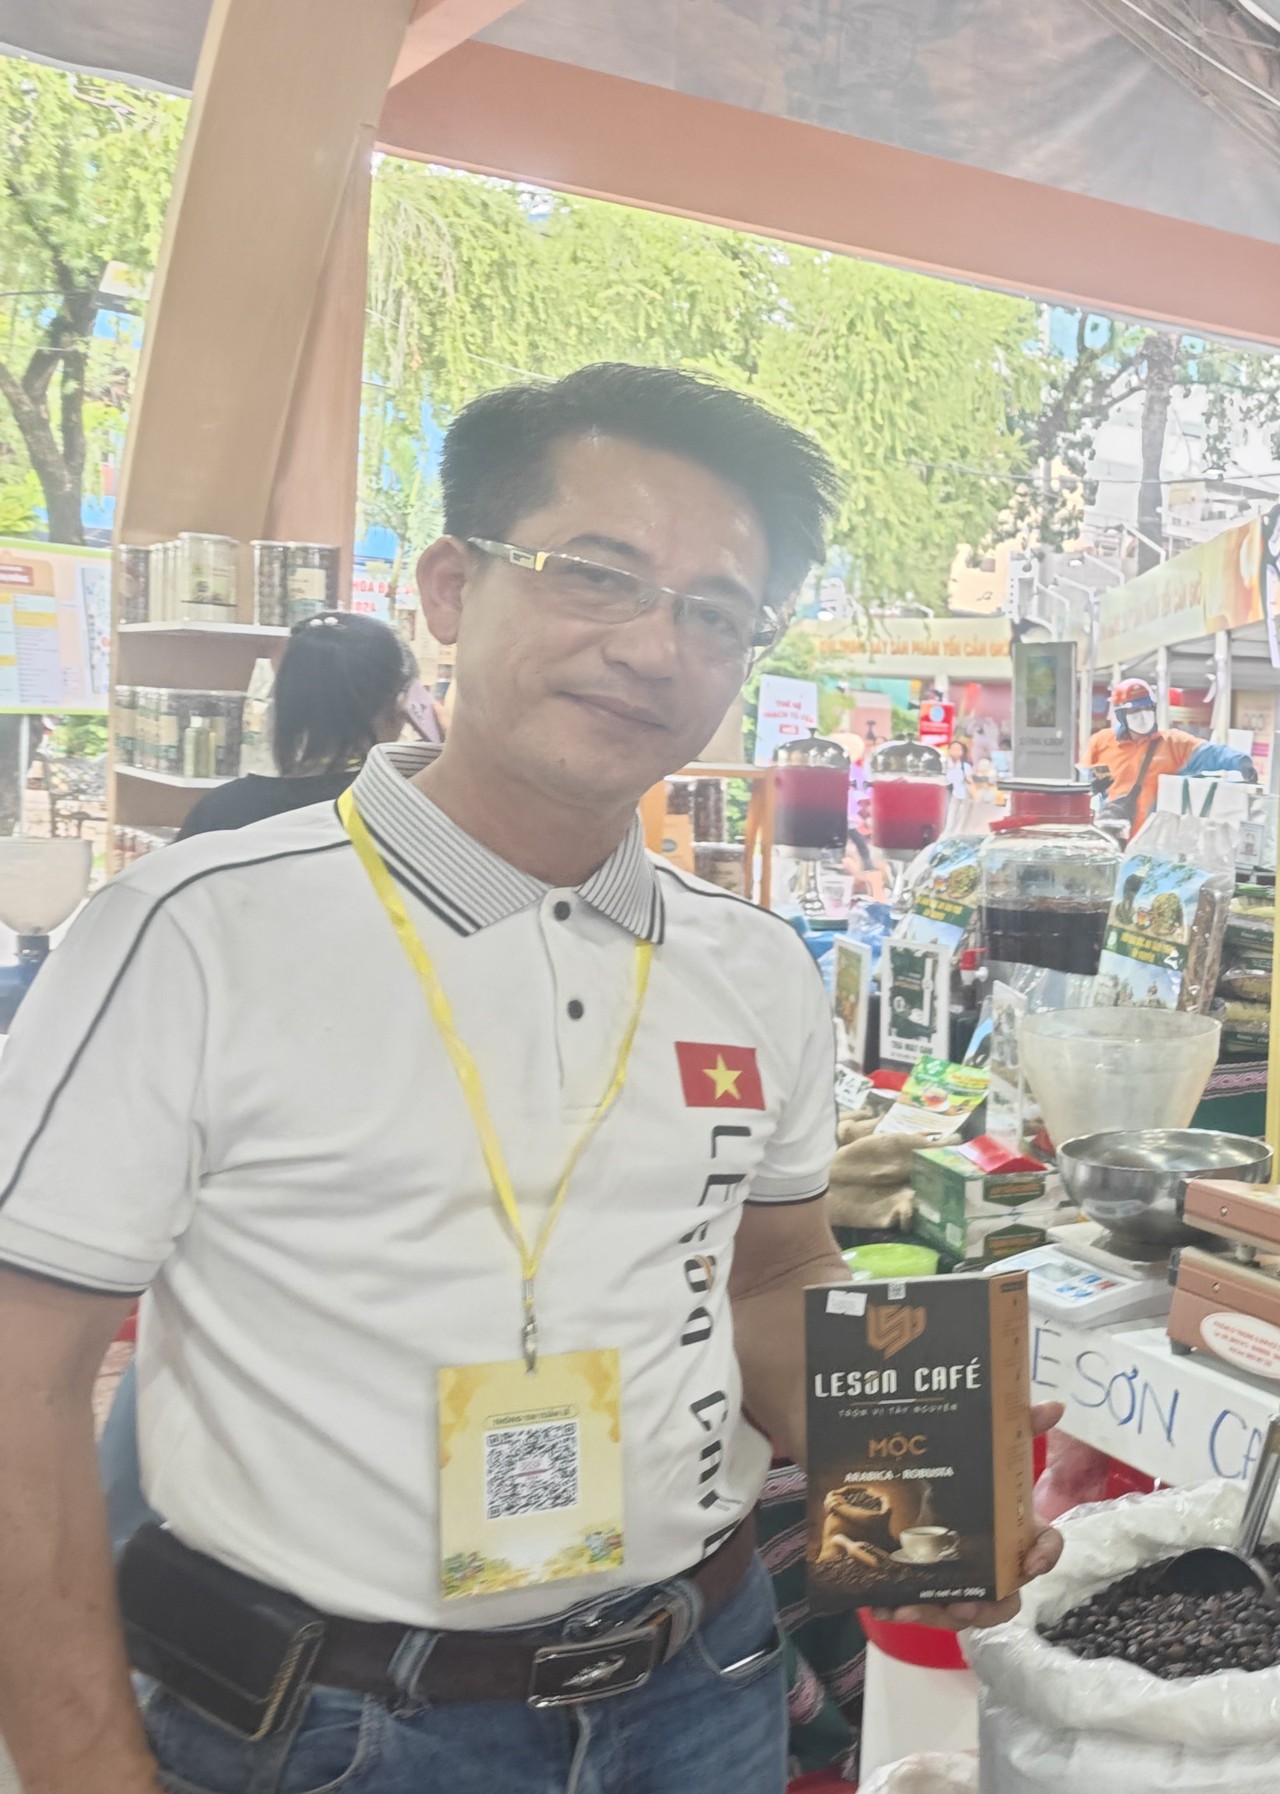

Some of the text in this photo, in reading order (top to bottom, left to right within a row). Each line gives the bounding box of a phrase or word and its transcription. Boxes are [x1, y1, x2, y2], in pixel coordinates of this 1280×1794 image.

[914, 1356, 982, 1392] CAFÉ
[868, 1431, 928, 1462] MỘC
[844, 1466, 955, 1483] ARABICA ROBUSTA
